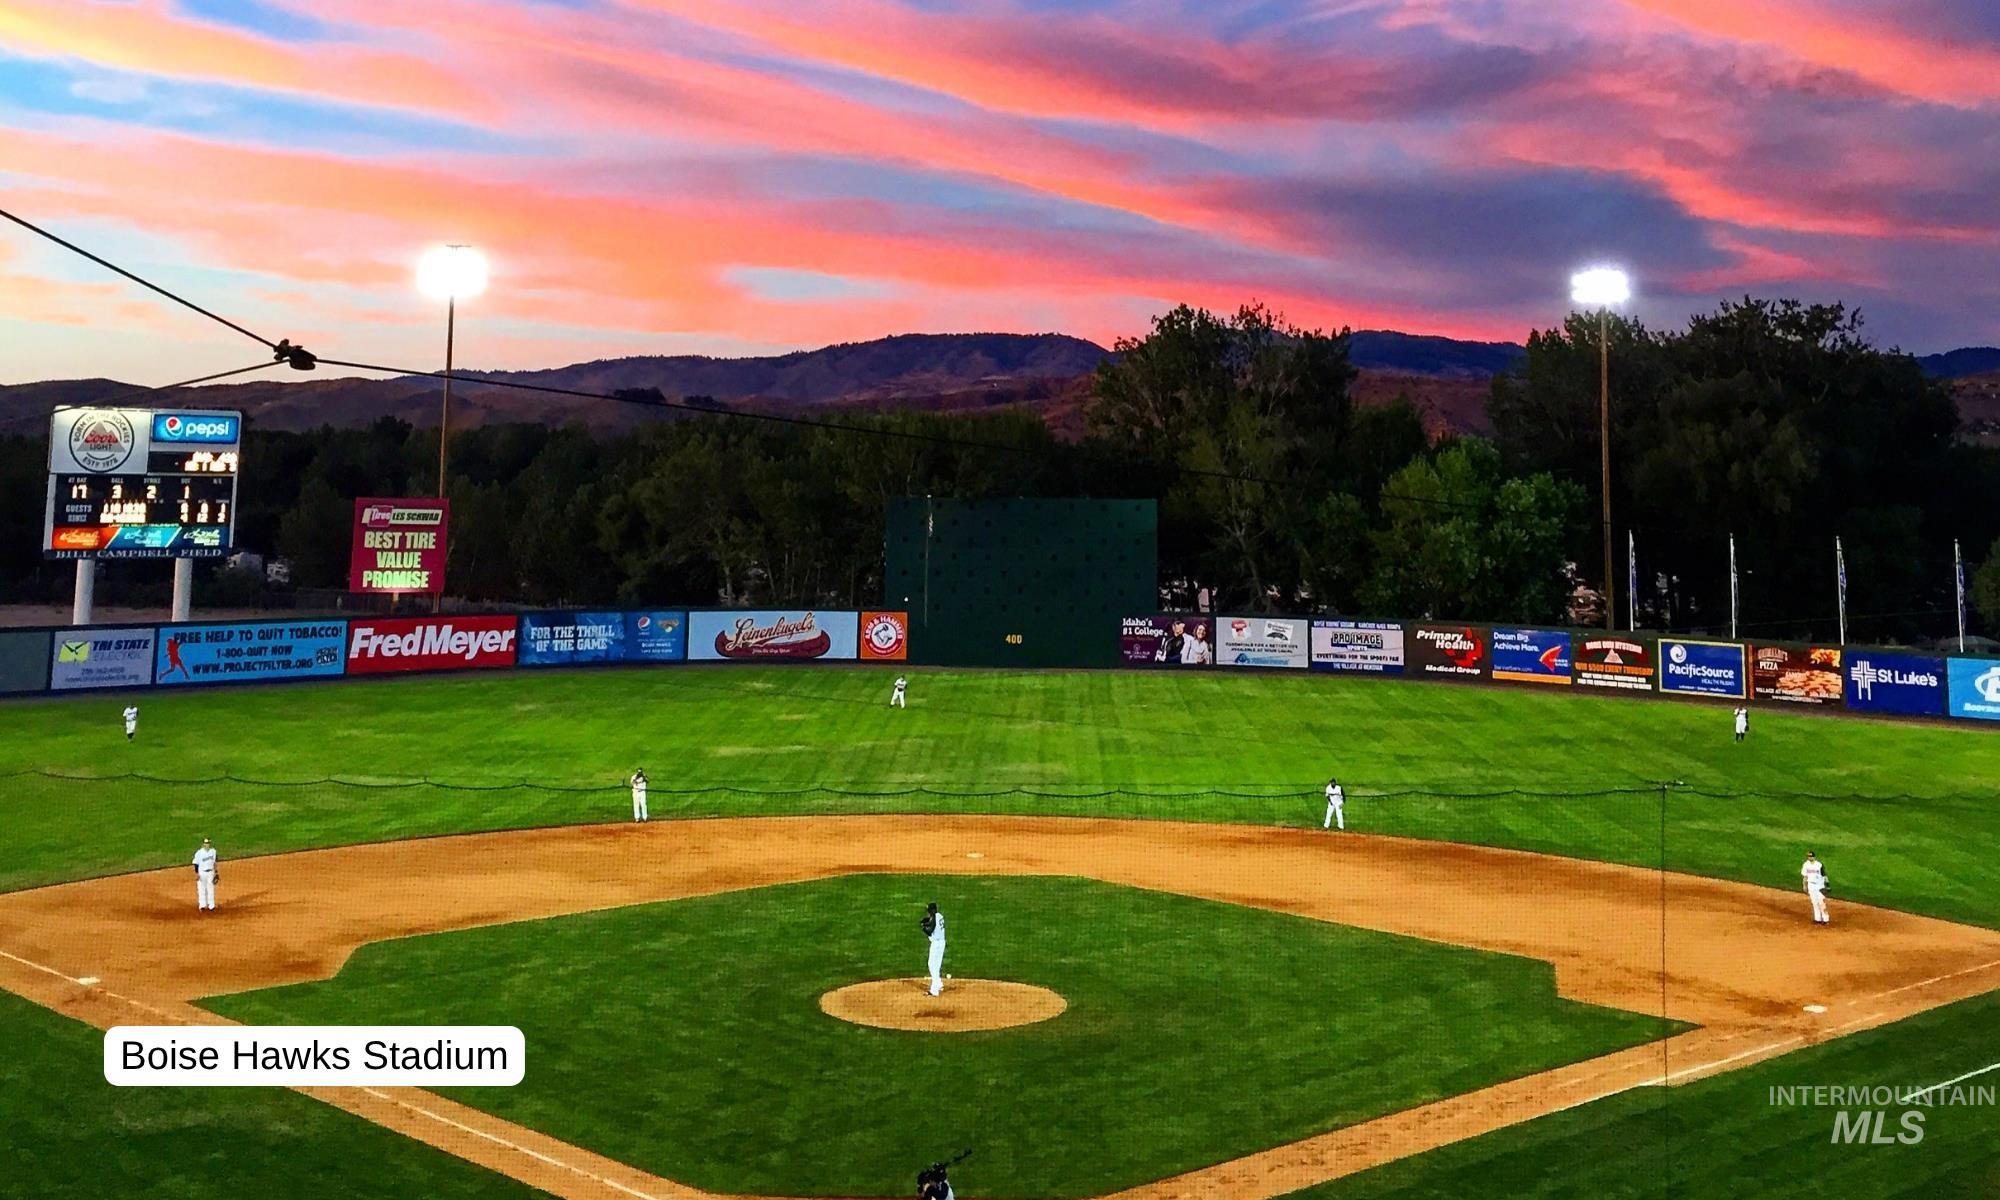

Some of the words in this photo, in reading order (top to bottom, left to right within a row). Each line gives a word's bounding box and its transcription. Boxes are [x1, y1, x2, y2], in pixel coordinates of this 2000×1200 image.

[84, 430, 118, 444] Coors
[185, 422, 230, 438] pepsi
[72, 484, 88, 499] 17
[112, 484, 122, 499] 3
[146, 485, 157, 500] 2
[184, 485, 190, 499] 1
[66, 504, 92, 512] GUESTS
[392, 512, 405, 521] LES
[406, 512, 440, 521] SCHWAB
[364, 531, 402, 549] BEST
[405, 532, 436, 549] TIRE
[55, 551, 91, 559] BILL
[97, 550, 174, 558] CAMPBELL
[181, 549, 222, 557] FIELD
[376, 551, 422, 569] VALUE
[362, 570, 430, 588] PROMISE
[865, 621, 875, 639] ARM
[880, 616, 904, 639] HAMMER
[1122, 618, 1153, 627] Idaho's
[174, 631, 201, 644] FREE
[205, 630, 234, 643] HELP
[238, 630, 253, 641] TO
[257, 628, 285, 641] QUIT
[289, 626, 343, 640] TOBACCO!
[530, 627, 551, 640] FOR
[553, 626, 575, 639] THE
[576, 625, 615, 638] THRILL
[724, 611, 816, 652] Leinenkugel's
[1134, 626, 1168, 638] College.
[1416, 630, 1464, 642] Primary
[1494, 632, 1516, 640] Dream
[92, 640, 113, 651] TRI
[114, 639, 151, 650] STATE
[536, 639, 550, 652] OF
[552, 639, 574, 652] THE
[577, 638, 608, 651] GAME
[1005, 633, 1023, 645] 400
[1332, 632, 1352, 644] PRO
[1352, 632, 1382, 646] IMAGE
[1436, 640, 1474, 650] Health
[271, 645, 294, 656] NOW
[1494, 642, 1520, 651] Achieve
[1425, 664, 1456, 672] Medical
[1456, 666, 1480, 675] Group
[1668, 663, 1735, 678] PacificSource
[1760, 661, 1778, 671] PIZZA
[1878, 668, 1893, 684] St
[1894, 670, 1938, 687] Luke's
